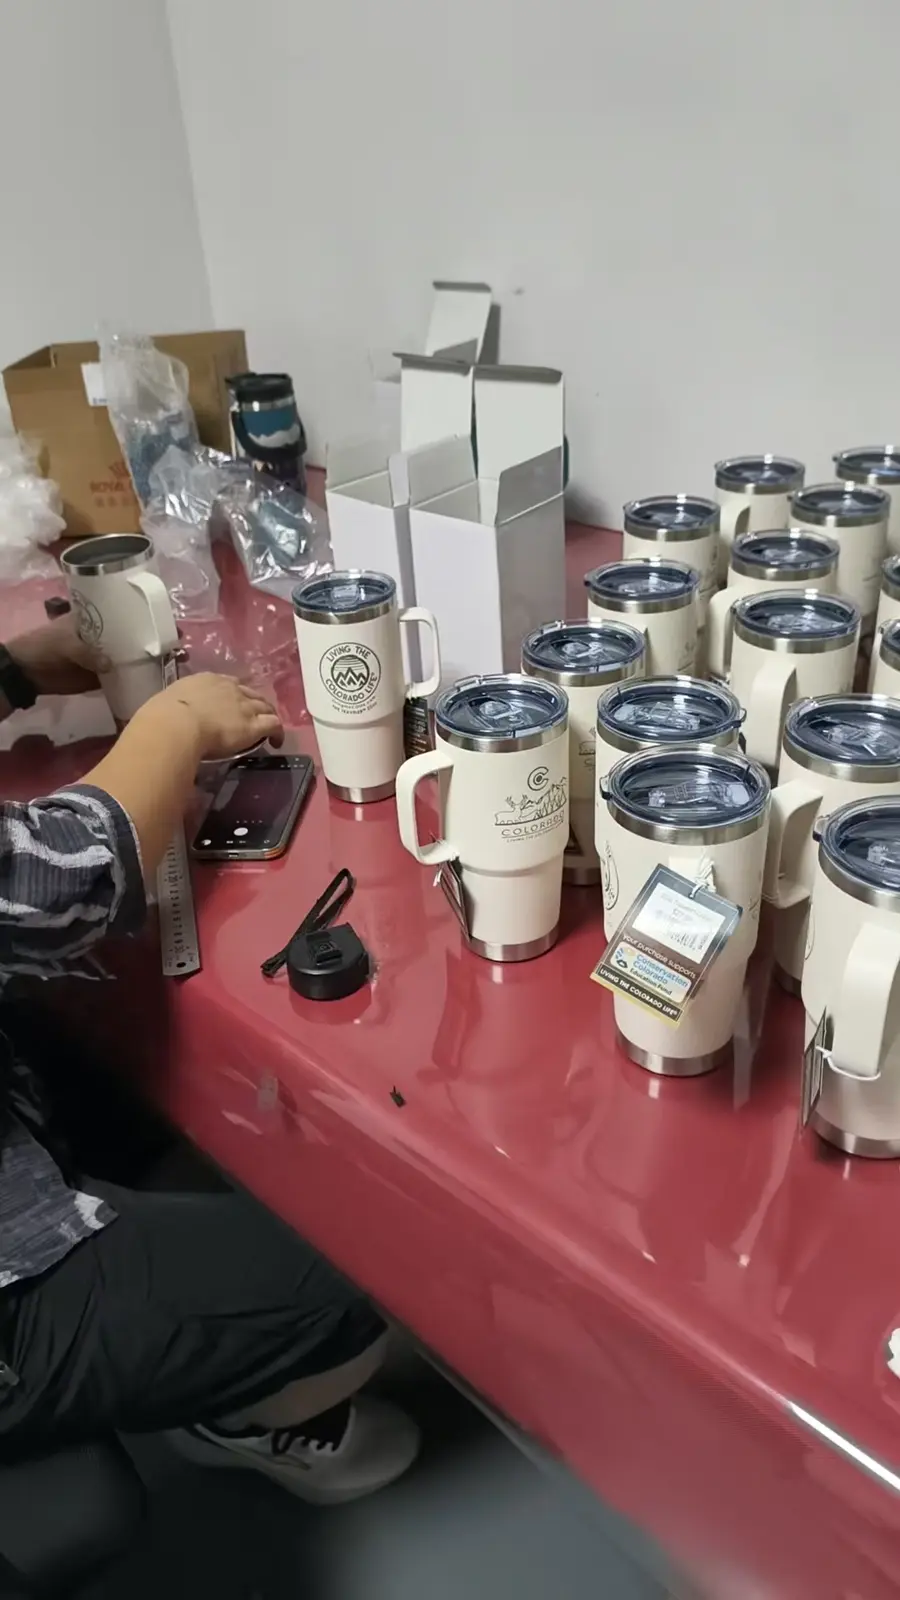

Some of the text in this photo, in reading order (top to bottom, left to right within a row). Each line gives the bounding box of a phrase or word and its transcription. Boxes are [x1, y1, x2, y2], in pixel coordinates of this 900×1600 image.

[326, 645, 371, 662] LIVING THE
[326, 678, 364, 702] COLORADO
[502, 810, 565, 836] COLORADO
[632, 961, 668, 984] Colorado
[636, 954, 688, 988] Conservation
[638, 942, 668, 963] purchase
[668, 958, 696, 979] supports
[600, 968, 619, 983] LIVING
[620, 979, 630, 990] THE
[630, 986, 662, 1008] COLORADO
[630, 968, 672, 996] Education Fund
